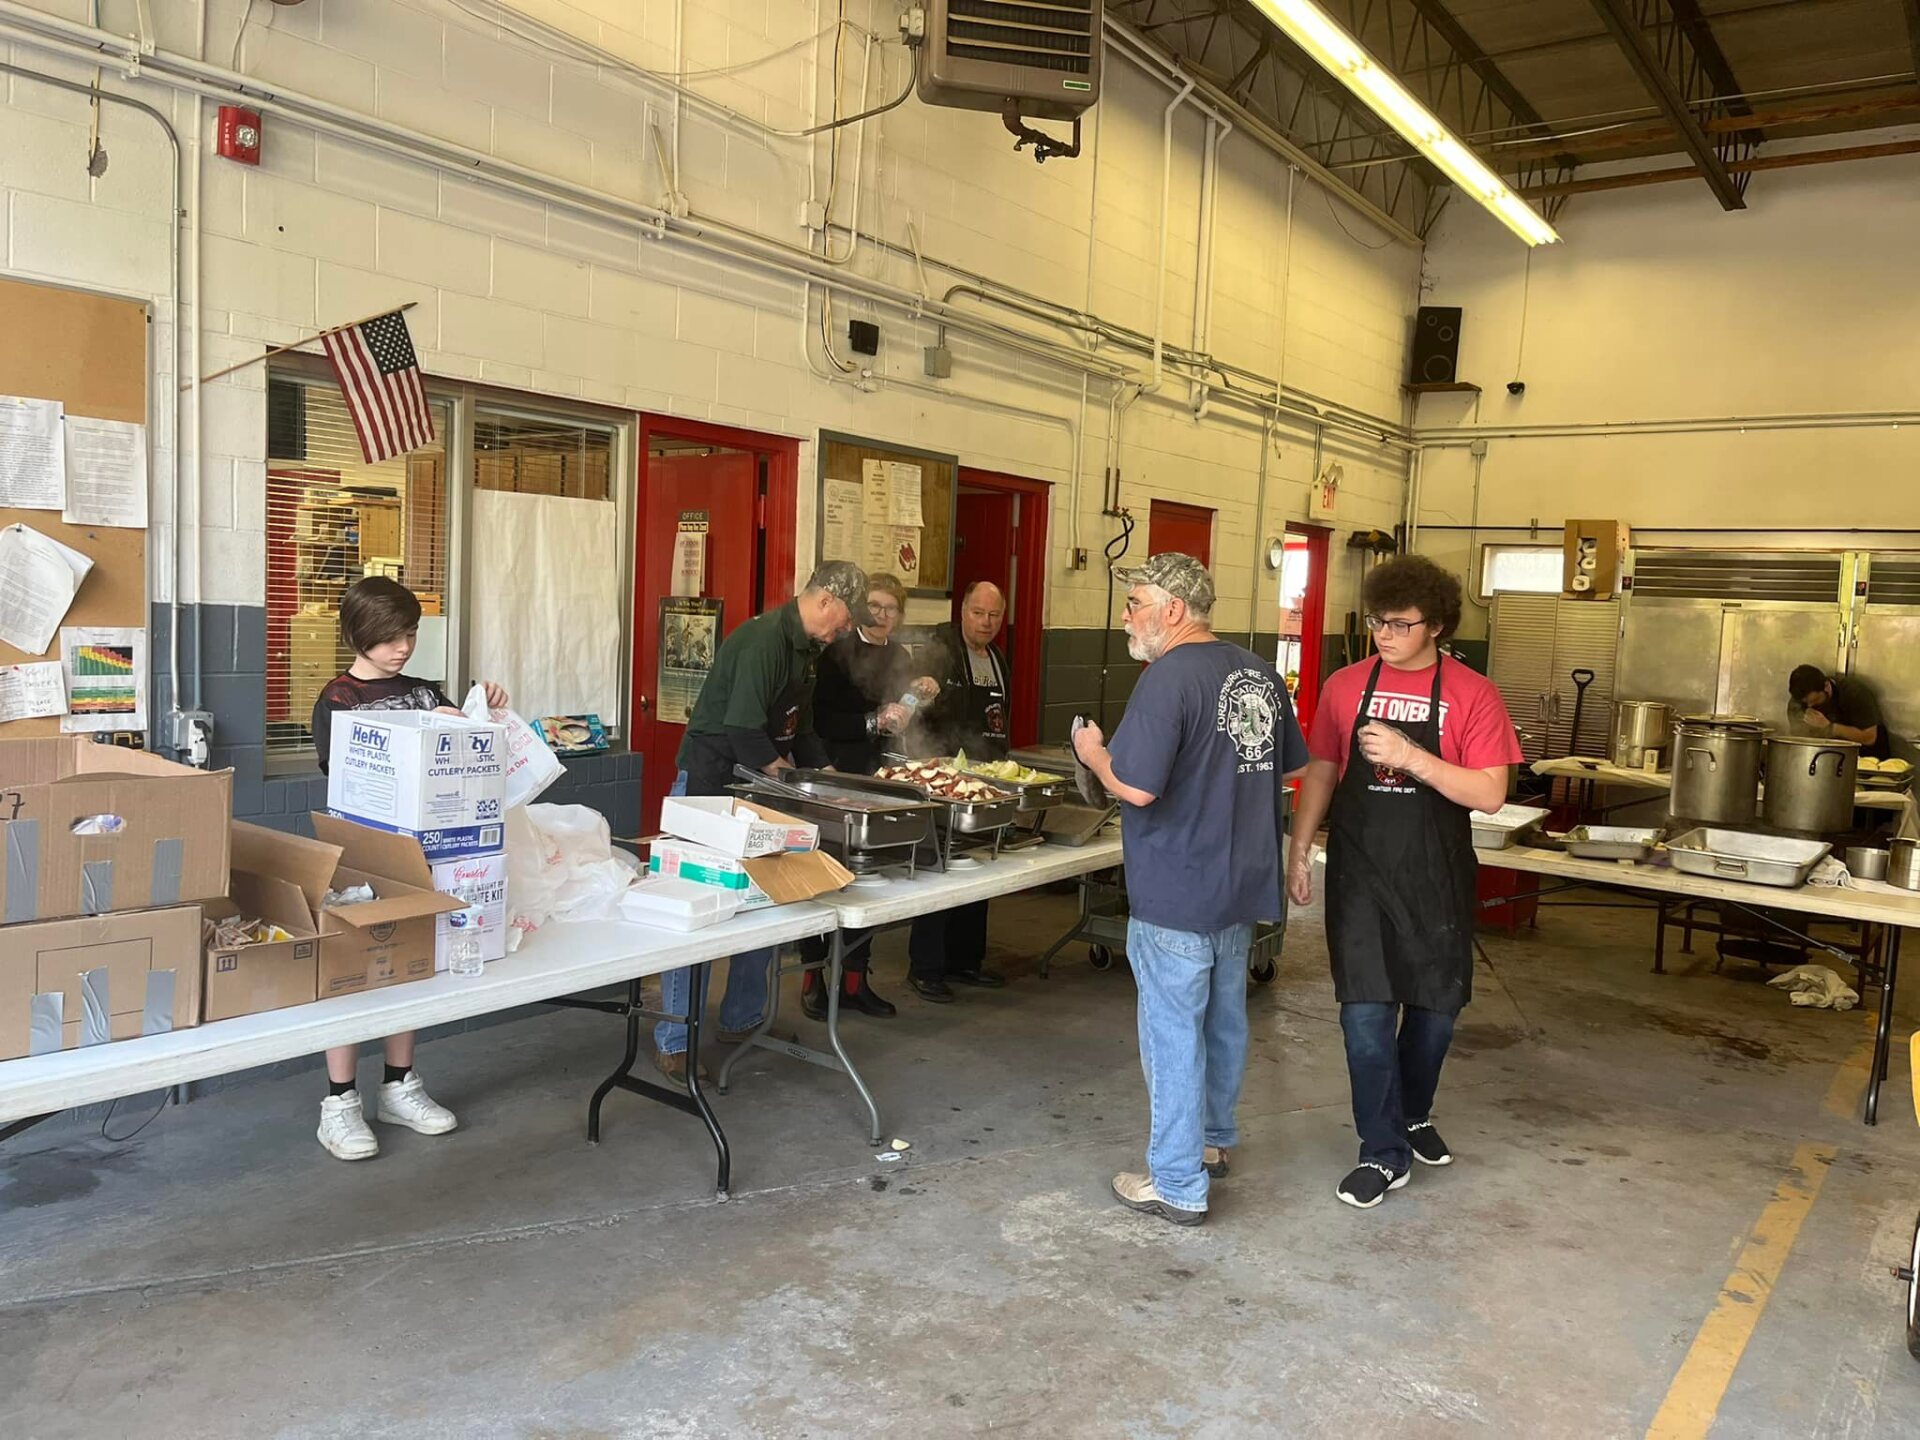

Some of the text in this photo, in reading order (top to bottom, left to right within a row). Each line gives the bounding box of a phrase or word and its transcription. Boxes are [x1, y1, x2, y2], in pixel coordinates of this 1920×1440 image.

[682, 512, 703, 520] OFFICE
[352, 725, 387, 750] Hefty
[367, 750, 391, 763] PLASTIC
[1245, 746, 1261, 758] 66
[344, 756, 396, 776] CUTLERY PACKETS
[515, 757, 528, 768] Day
[428, 767, 464, 777] CUTLERY
[466, 765, 500, 774] PACKETS
[423, 832, 440, 844] 250
[750, 832, 774, 841] PLASTIC
[747, 841, 765, 849] BAGS
[491, 889, 503, 901] KIT
